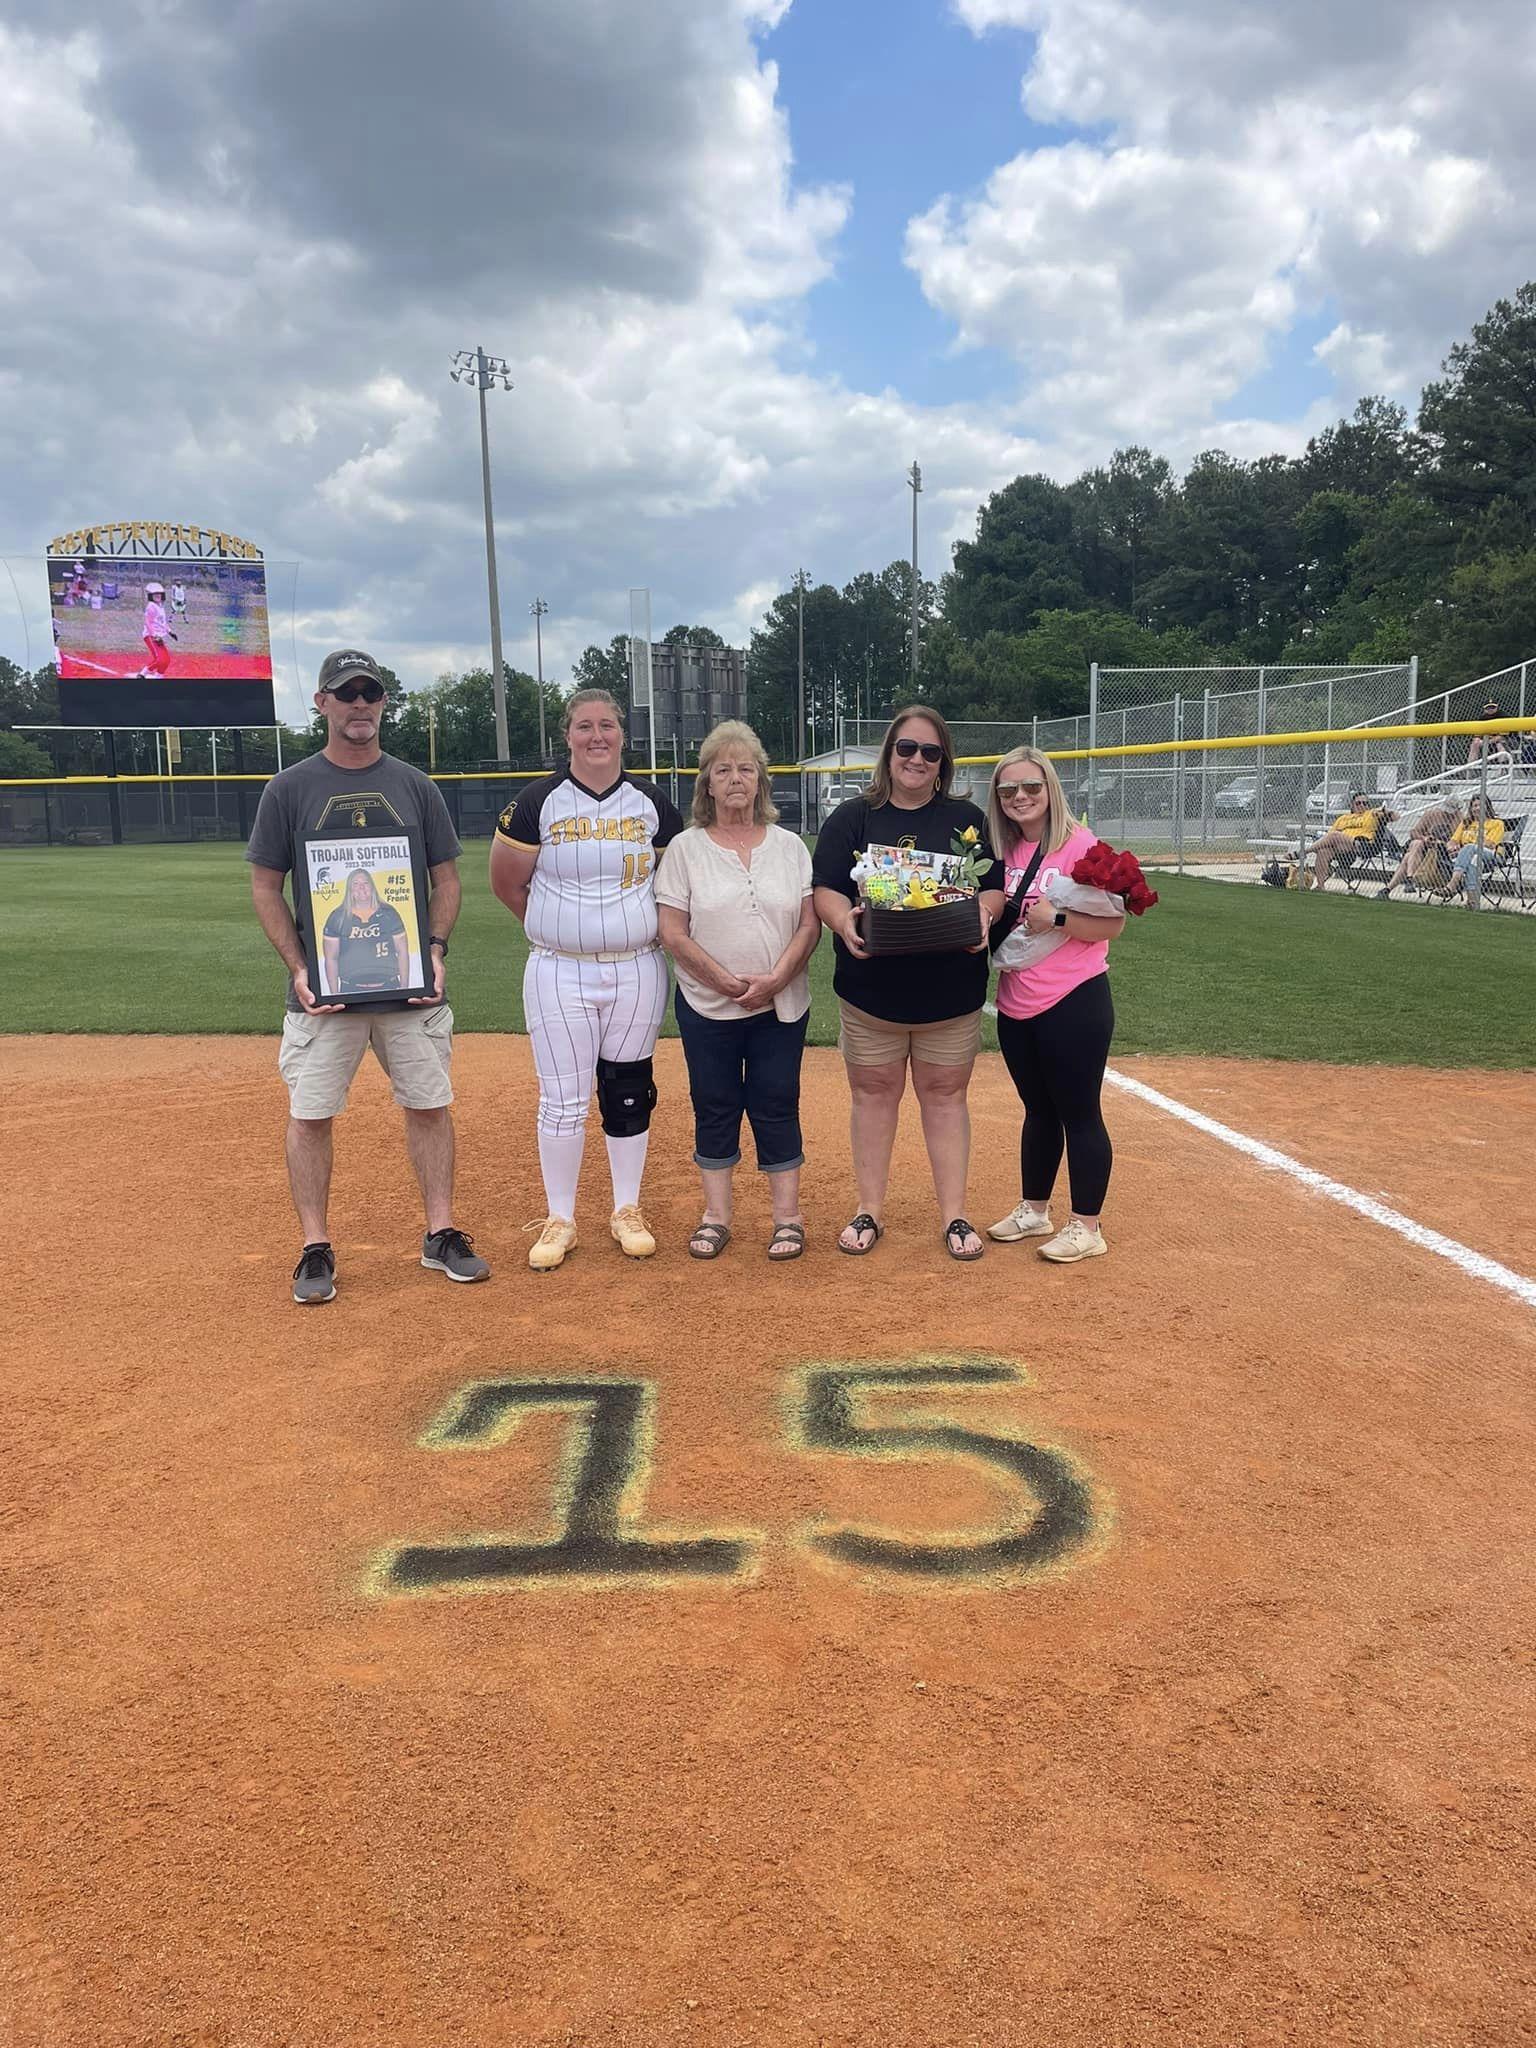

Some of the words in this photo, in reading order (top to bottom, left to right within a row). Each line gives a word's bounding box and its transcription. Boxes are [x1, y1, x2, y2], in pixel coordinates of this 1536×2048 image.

[52, 521, 201, 554] FAYETTEVILLE
[207, 528, 258, 559] TECH
[549, 816, 647, 845] TROJANS
[310, 847, 354, 863] TROJAN
[356, 845, 409, 861] SOFTBALL
[387, 875, 406, 885] #15
[621, 852, 652, 889] 15
[386, 895, 410, 903] Frank
[375, 941, 389, 958] 15
[368, 1356, 1112, 1594] 15
